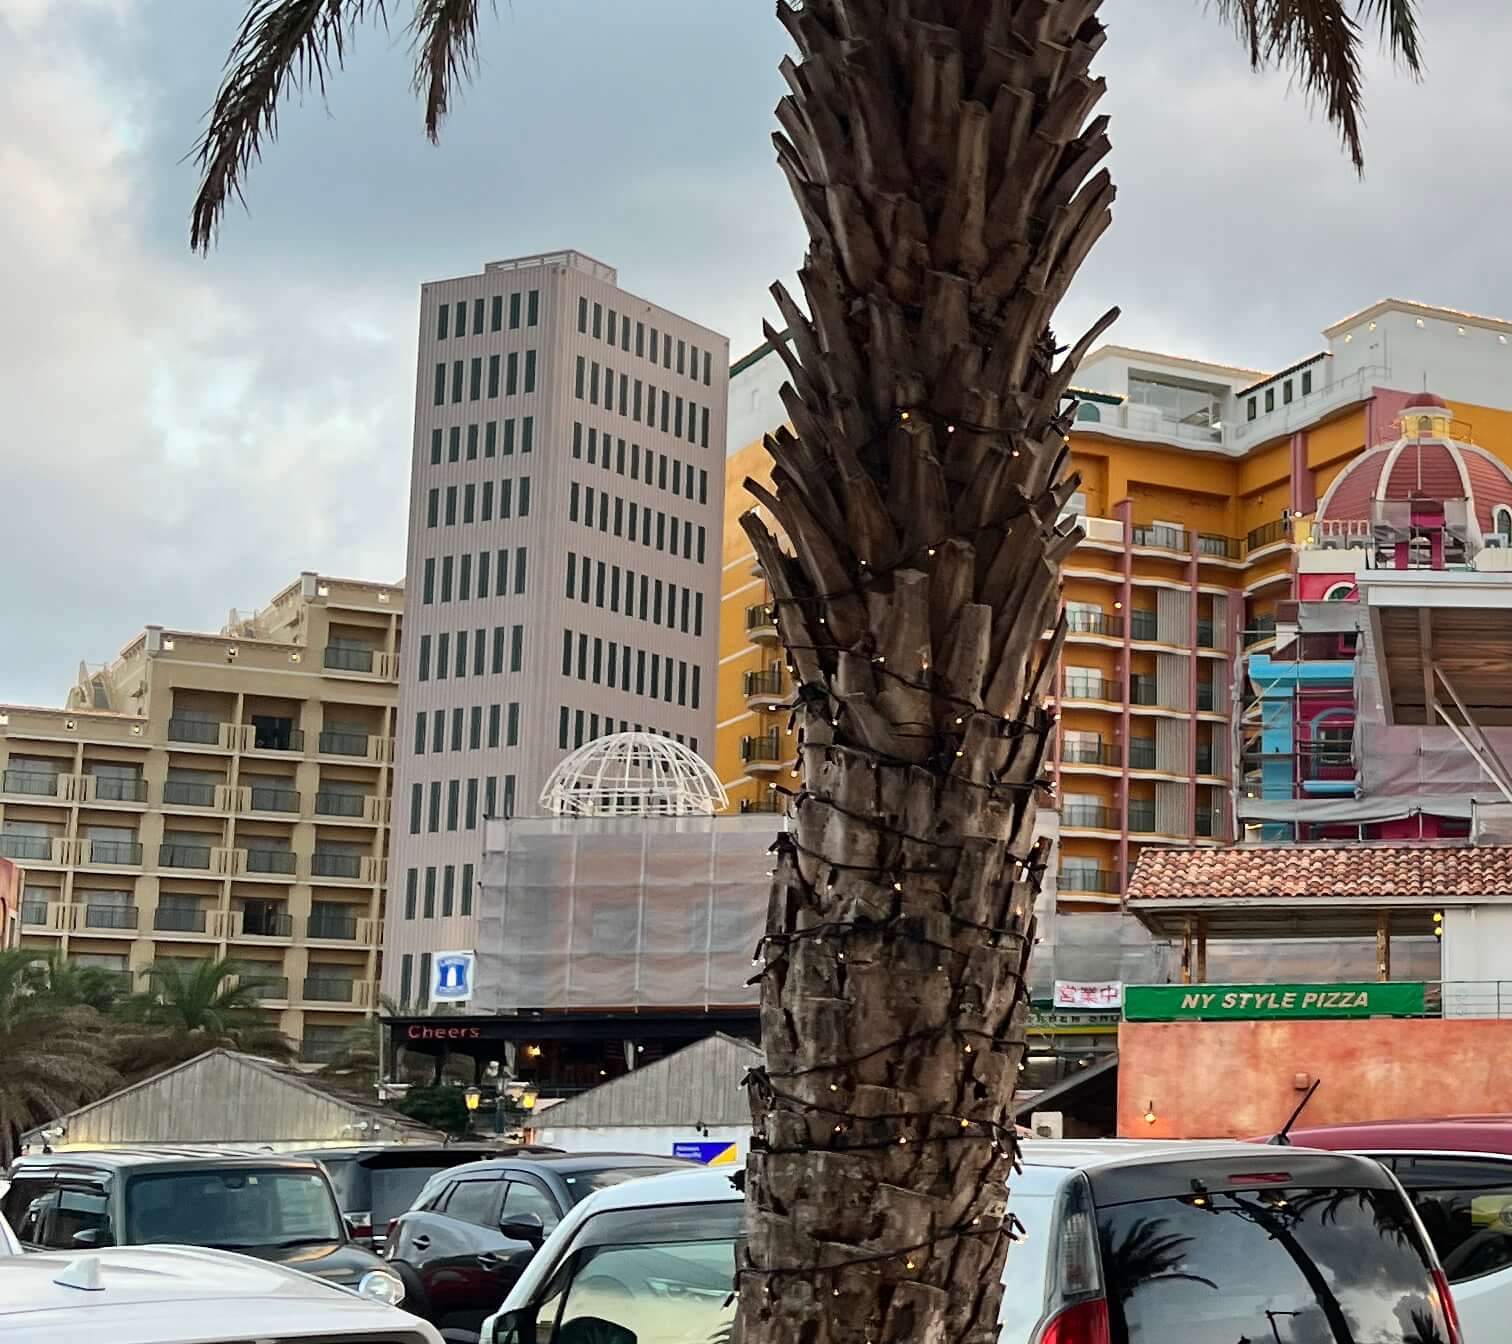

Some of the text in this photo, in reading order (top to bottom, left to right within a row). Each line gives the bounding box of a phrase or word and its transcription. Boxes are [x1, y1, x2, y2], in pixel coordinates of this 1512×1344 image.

[1181, 991, 1369, 1009] NY STYLE PIZZA
[408, 1024, 480, 1039] Cheers
